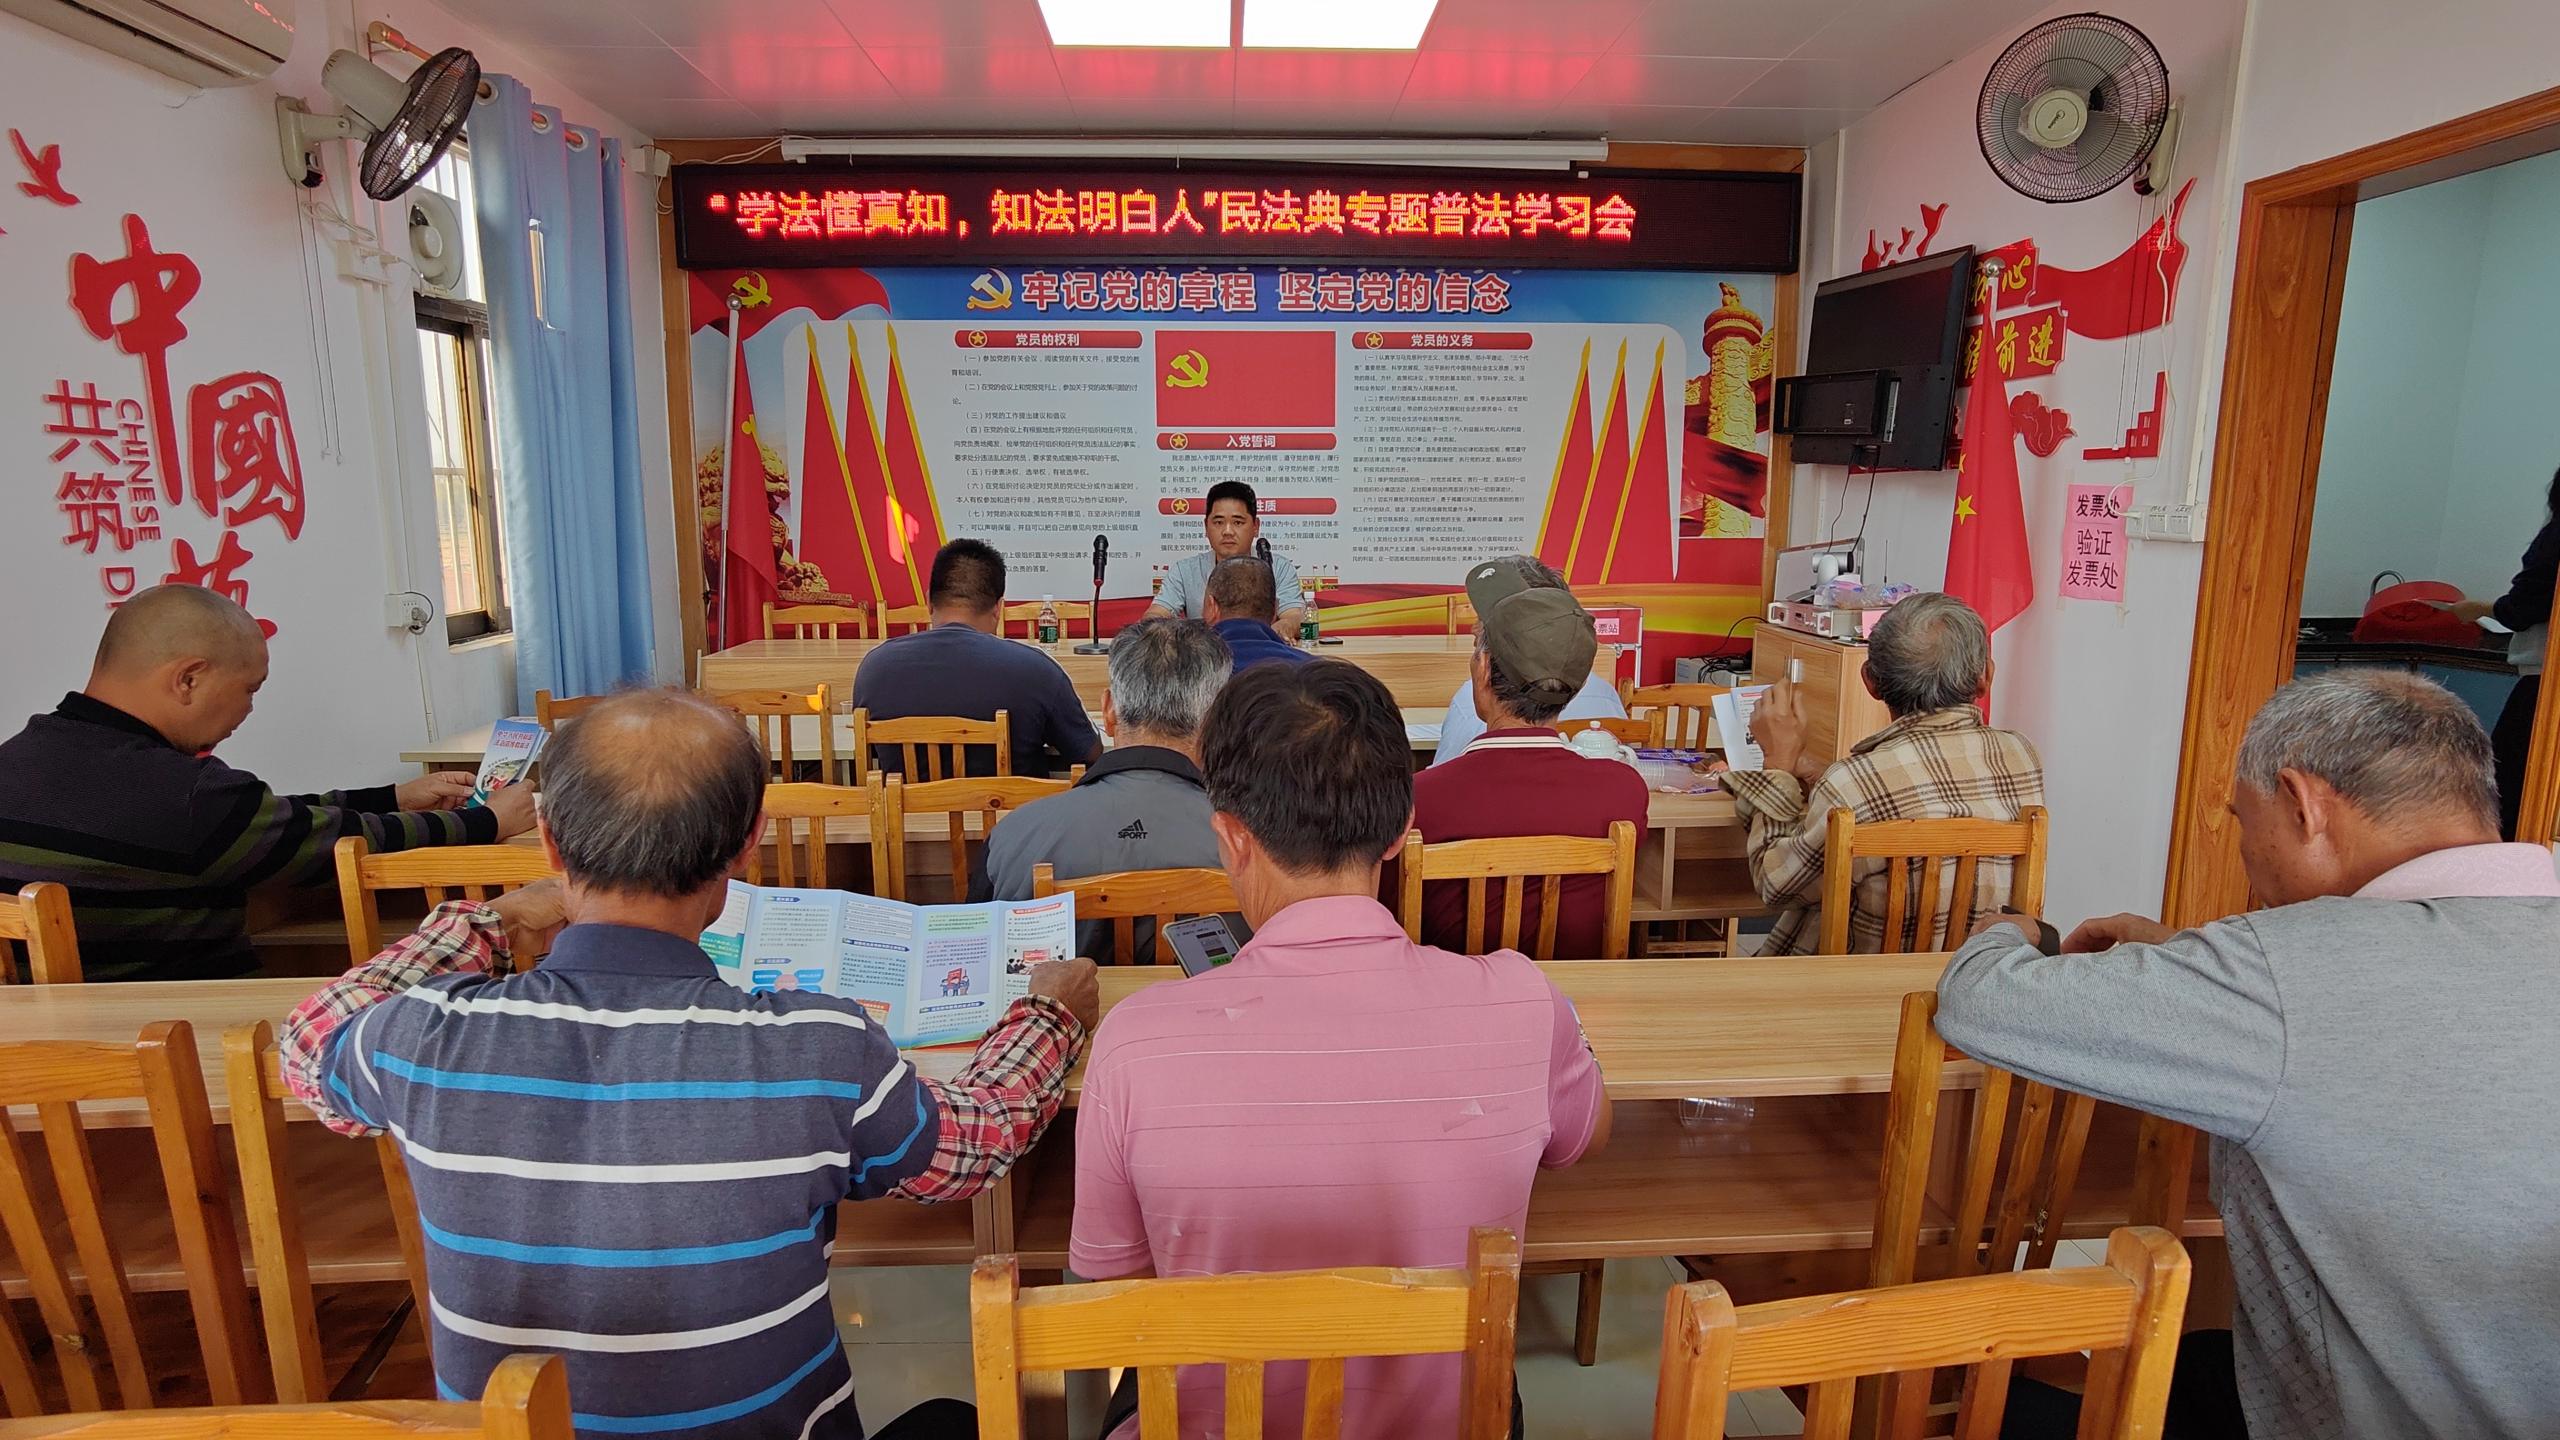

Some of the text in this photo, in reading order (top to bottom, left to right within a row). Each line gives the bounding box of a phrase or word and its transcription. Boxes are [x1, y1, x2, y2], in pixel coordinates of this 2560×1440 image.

[1021, 271, 1512, 314] 牢记党的章程 坚定党的信念
[1015, 333, 1080, 346] 党员的权利
[1411, 334, 1474, 347] 党员的义务
[1226, 435, 1276, 448] 入党誓词
[43, 379, 136, 554] 共筑
[114, 398, 161, 542] CHINESE
[2075, 494, 2121, 519] 发票处
[2077, 529, 2113, 556] 验证
[2066, 560, 2119, 590] 发票处
[1118, 831, 1148, 840] SPORT
